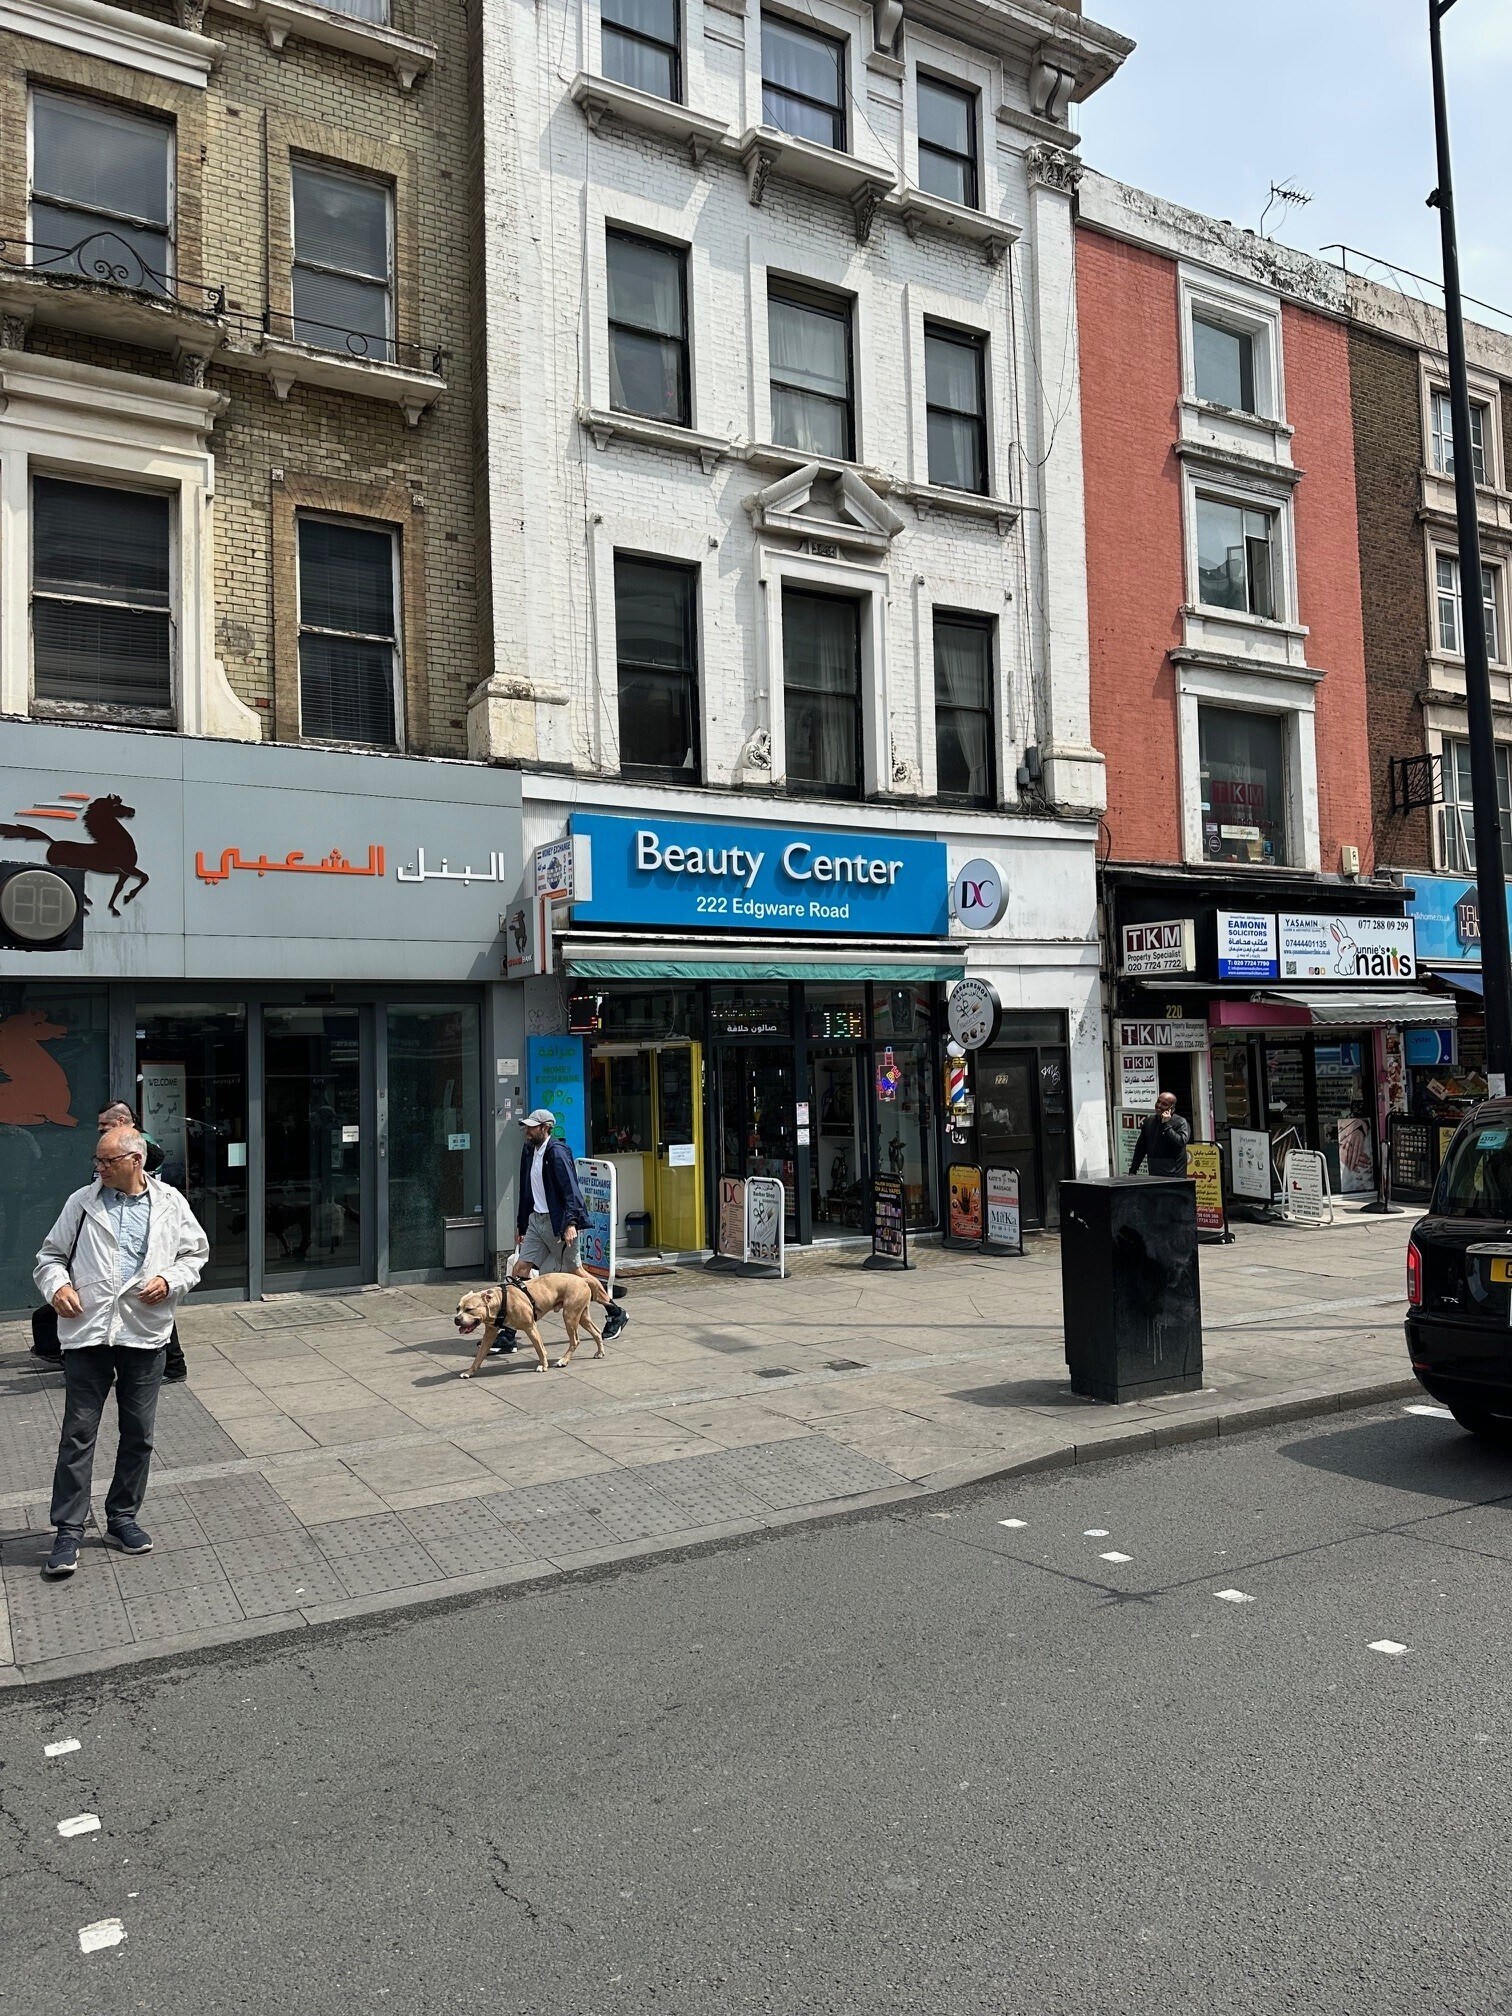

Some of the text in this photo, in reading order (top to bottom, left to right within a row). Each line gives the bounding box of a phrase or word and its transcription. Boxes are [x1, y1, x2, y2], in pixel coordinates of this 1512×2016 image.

[635, 830, 904, 889] Beauty Center
[195, 845, 386, 886] الشعبي
[397, 847, 505, 886] البنك
[961, 879, 995, 909] DC
[696, 896, 850, 918] 222 Edgware Road
[1410, 911, 1451, 922] talkhome.co.uk
[1460, 904, 1480, 922] TAL
[1228, 920, 1267, 930] EAMONN
[1358, 920, 1409, 931] 077 288 09 299
[1128, 926, 1181, 950] TKM
[1228, 929, 1268, 937] SOLICITORS
[1285, 939, 1328, 949] 07444401135
[1127, 950, 1182, 963] Property Specialist
[1128, 960, 1182, 971] 020 7724 7722
[952, 982, 988, 999] BARBERSHOP
[1166, 1004, 1182, 1018] 220
[727, 1024, 777, 1035] صالون حلاقة
[1172, 1021, 1185, 1030] Property
[1123, 1025, 1171, 1045] TKM
[1411, 1036, 1432, 1045] oyster
[1124, 1057, 1154, 1068] TKM
[543, 1065, 572, 1074] MONEY
[148, 1078, 178, 1086] WELCOME
[535, 1074, 580, 1084] EXCHANGE
[995, 1075, 1009, 1085] 222
[1141, 1074, 1155, 1084] مكتب
[590, 1178, 611, 1190] EXCHANGE
[585, 1187, 605, 1197] BEST RATES
[723, 1181, 742, 1204] DC
[991, 1224, 1017, 1234] nails
